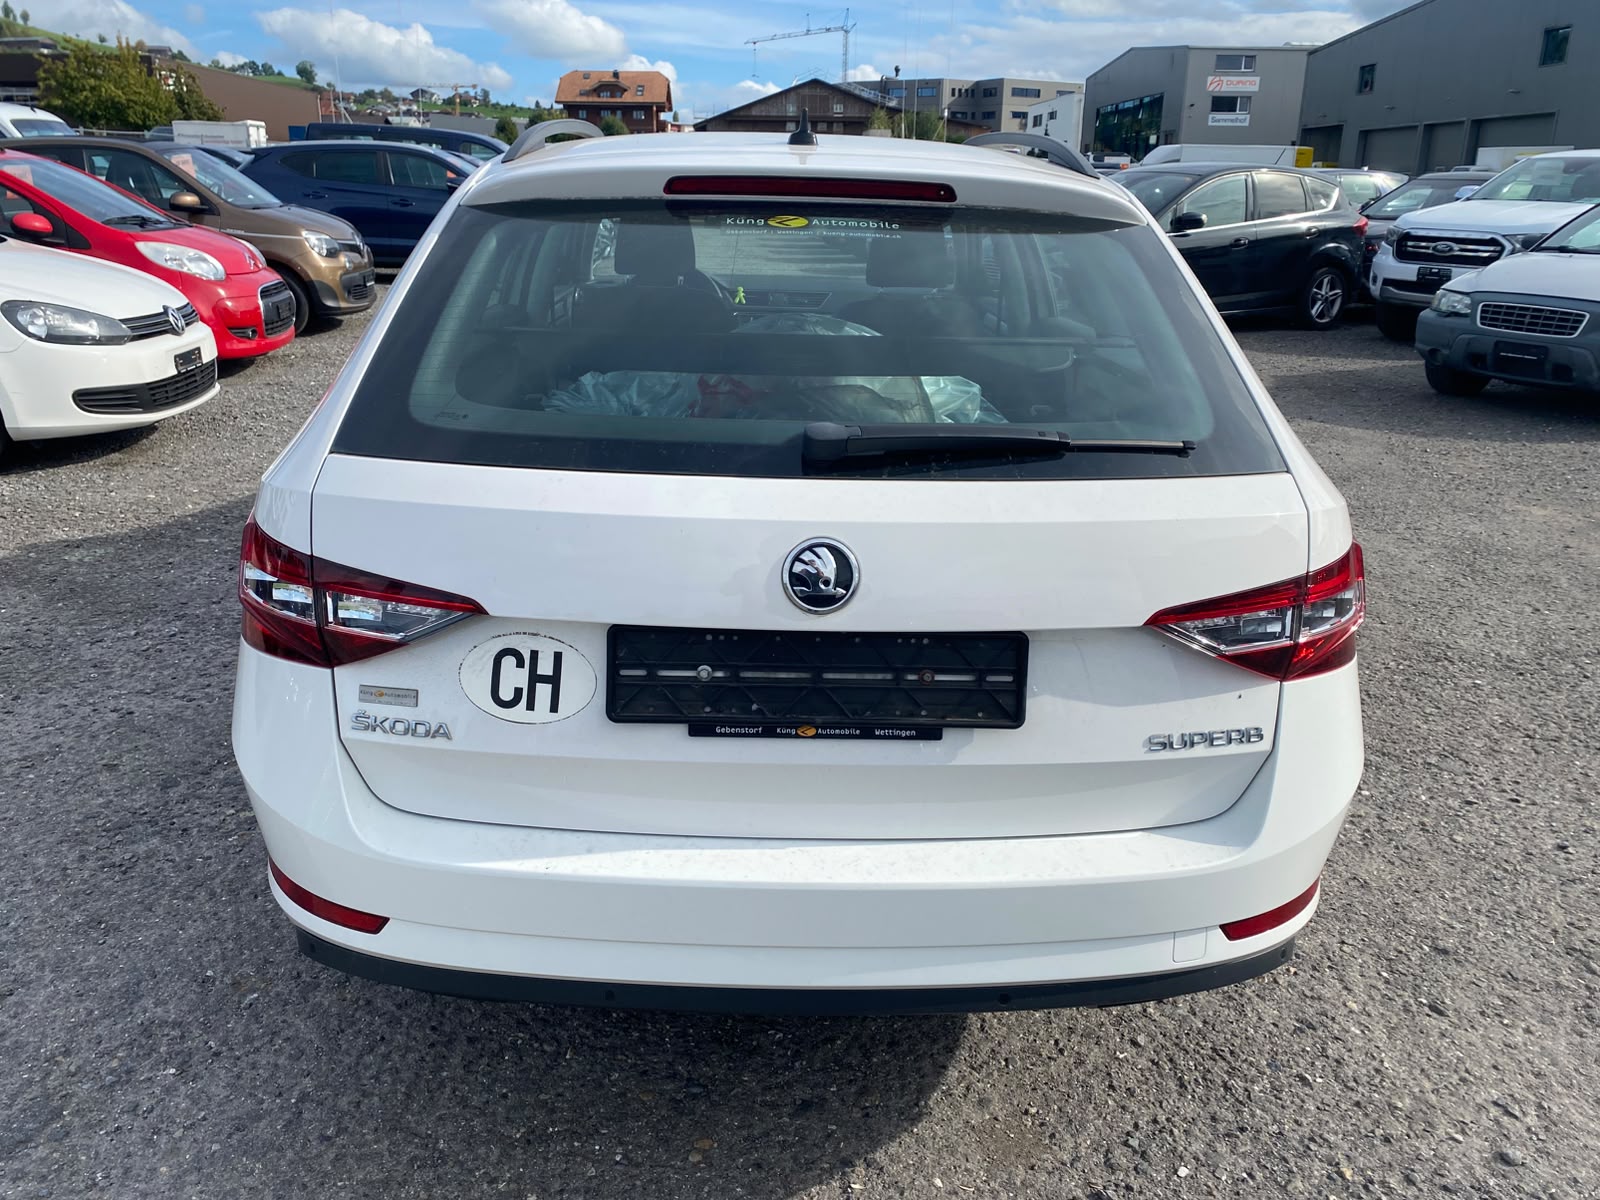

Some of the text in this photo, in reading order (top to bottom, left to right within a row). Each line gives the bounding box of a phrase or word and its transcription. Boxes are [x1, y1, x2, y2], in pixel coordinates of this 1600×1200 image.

[725, 216, 901, 230] Küng Automobile
[490, 647, 563, 714] CH
[351, 709, 453, 741] ŠKODA
[715, 725, 916, 738] Gebenstorf Küng Automobile Wettingen
[1146, 727, 1264, 752] SUPERB
